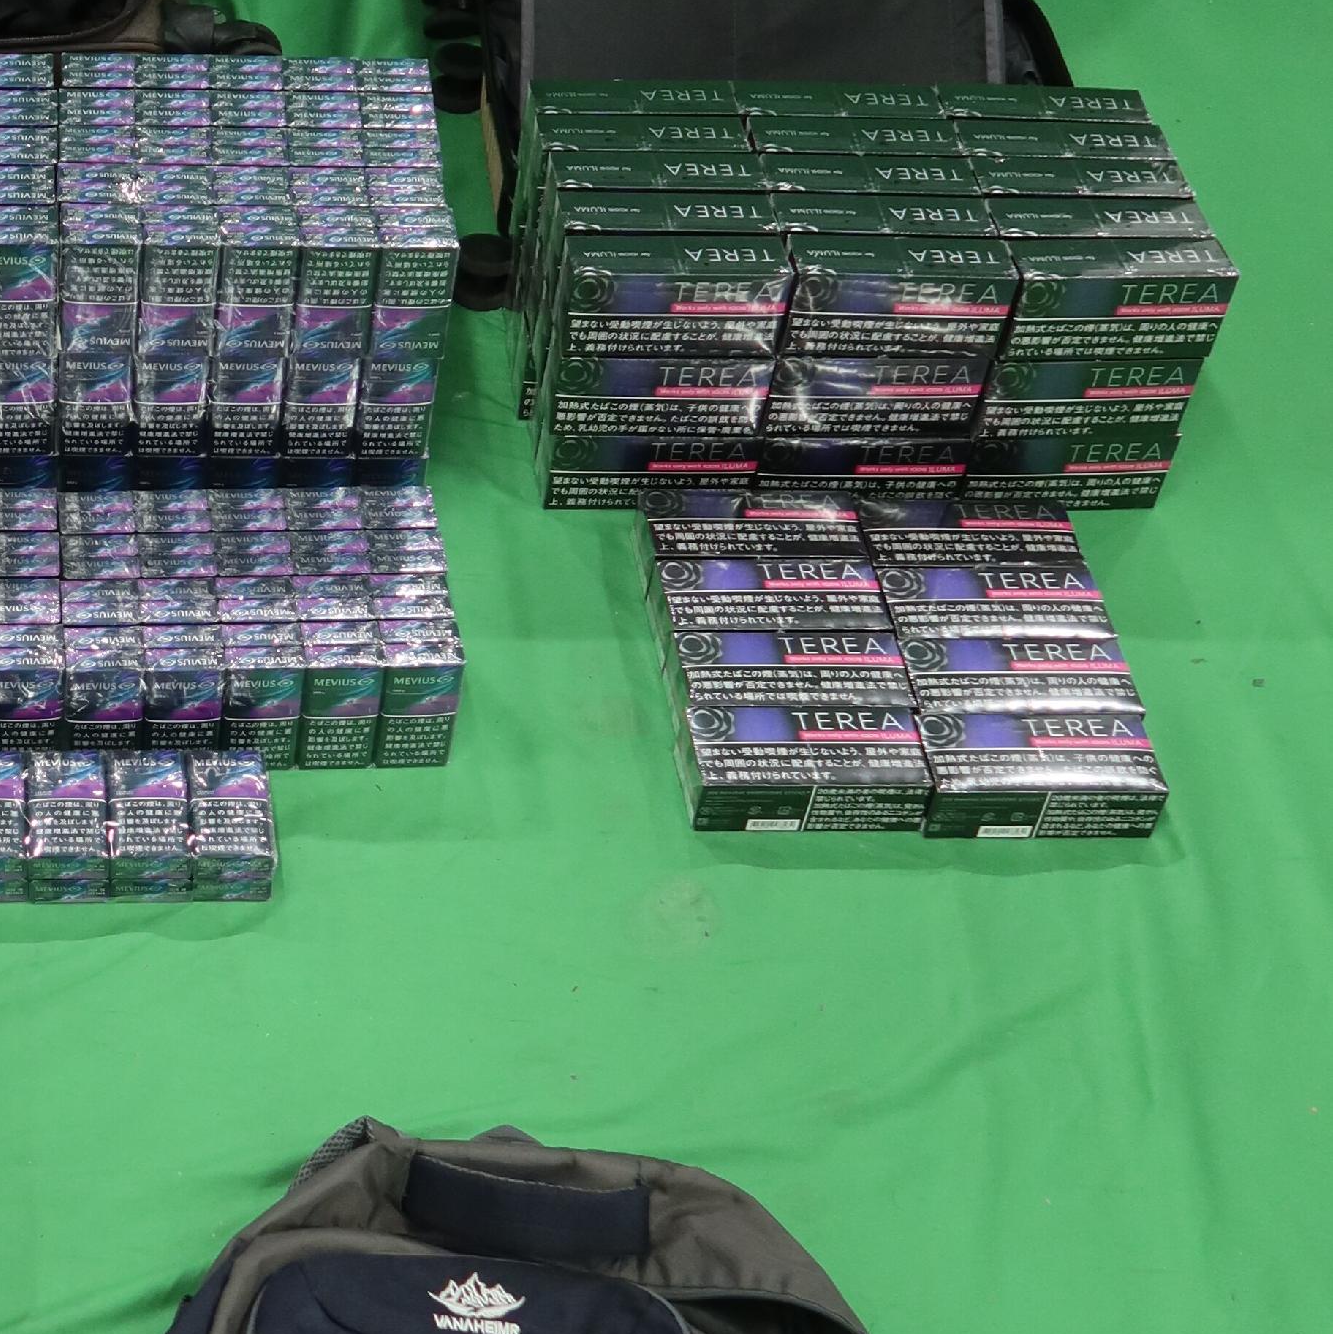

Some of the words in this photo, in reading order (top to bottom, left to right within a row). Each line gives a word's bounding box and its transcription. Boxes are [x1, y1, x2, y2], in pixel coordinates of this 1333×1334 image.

[641, 90, 724, 101] TEREA
[844, 93, 928, 106] TEREA
[1050, 97, 1135, 109] TEREA
[648, 128, 734, 138] TEREA
[861, 130, 949, 142] TEREA
[1070, 133, 1155, 147] TEREA
[664, 164, 752, 176] TEREA
[874, 168, 963, 181] TEREA
[1087, 171, 1177, 183] TEREA
[674, 205, 763, 218] TEREA
[889, 208, 978, 221] TEREA
[1104, 211, 1194, 224] TEREA
[683, 249, 776, 261] TEREA
[908, 250, 1001, 264] TEREA
[1127, 250, 1217, 263] TEREA
[1122, 283, 1218, 304] TEREA
[320, 340, 362, 349] MEVIUS
[397, 340, 438, 350] MEVIUS
[65, 361, 106, 371] MEVIUS
[142, 361, 183, 372] MEVIUS
[219, 362, 260, 372] MEVIUS
[295, 362, 336, 372] MEVIUS
[371, 363, 412, 373] MEVIUS
[659, 367, 757, 386] TEREA
[1091, 366, 1184, 387] TEREA
[651, 442, 746, 461] TEREA
[863, 444, 954, 463] TEREA
[1070, 442, 1162, 462] TEREA
[958, 504, 1057, 520] TEREA
[757, 564, 863, 580] TEREA
[978, 572, 1085, 589] TEREA
[778, 638, 887, 655] TEREA
[1003, 644, 1112, 661] TEREA
[314, 678, 355, 687] MEVIUS
[394, 677, 435, 685] MEVIUS
[792, 712, 904, 730] TEREA
[1022, 719, 1134, 737] TEREA
